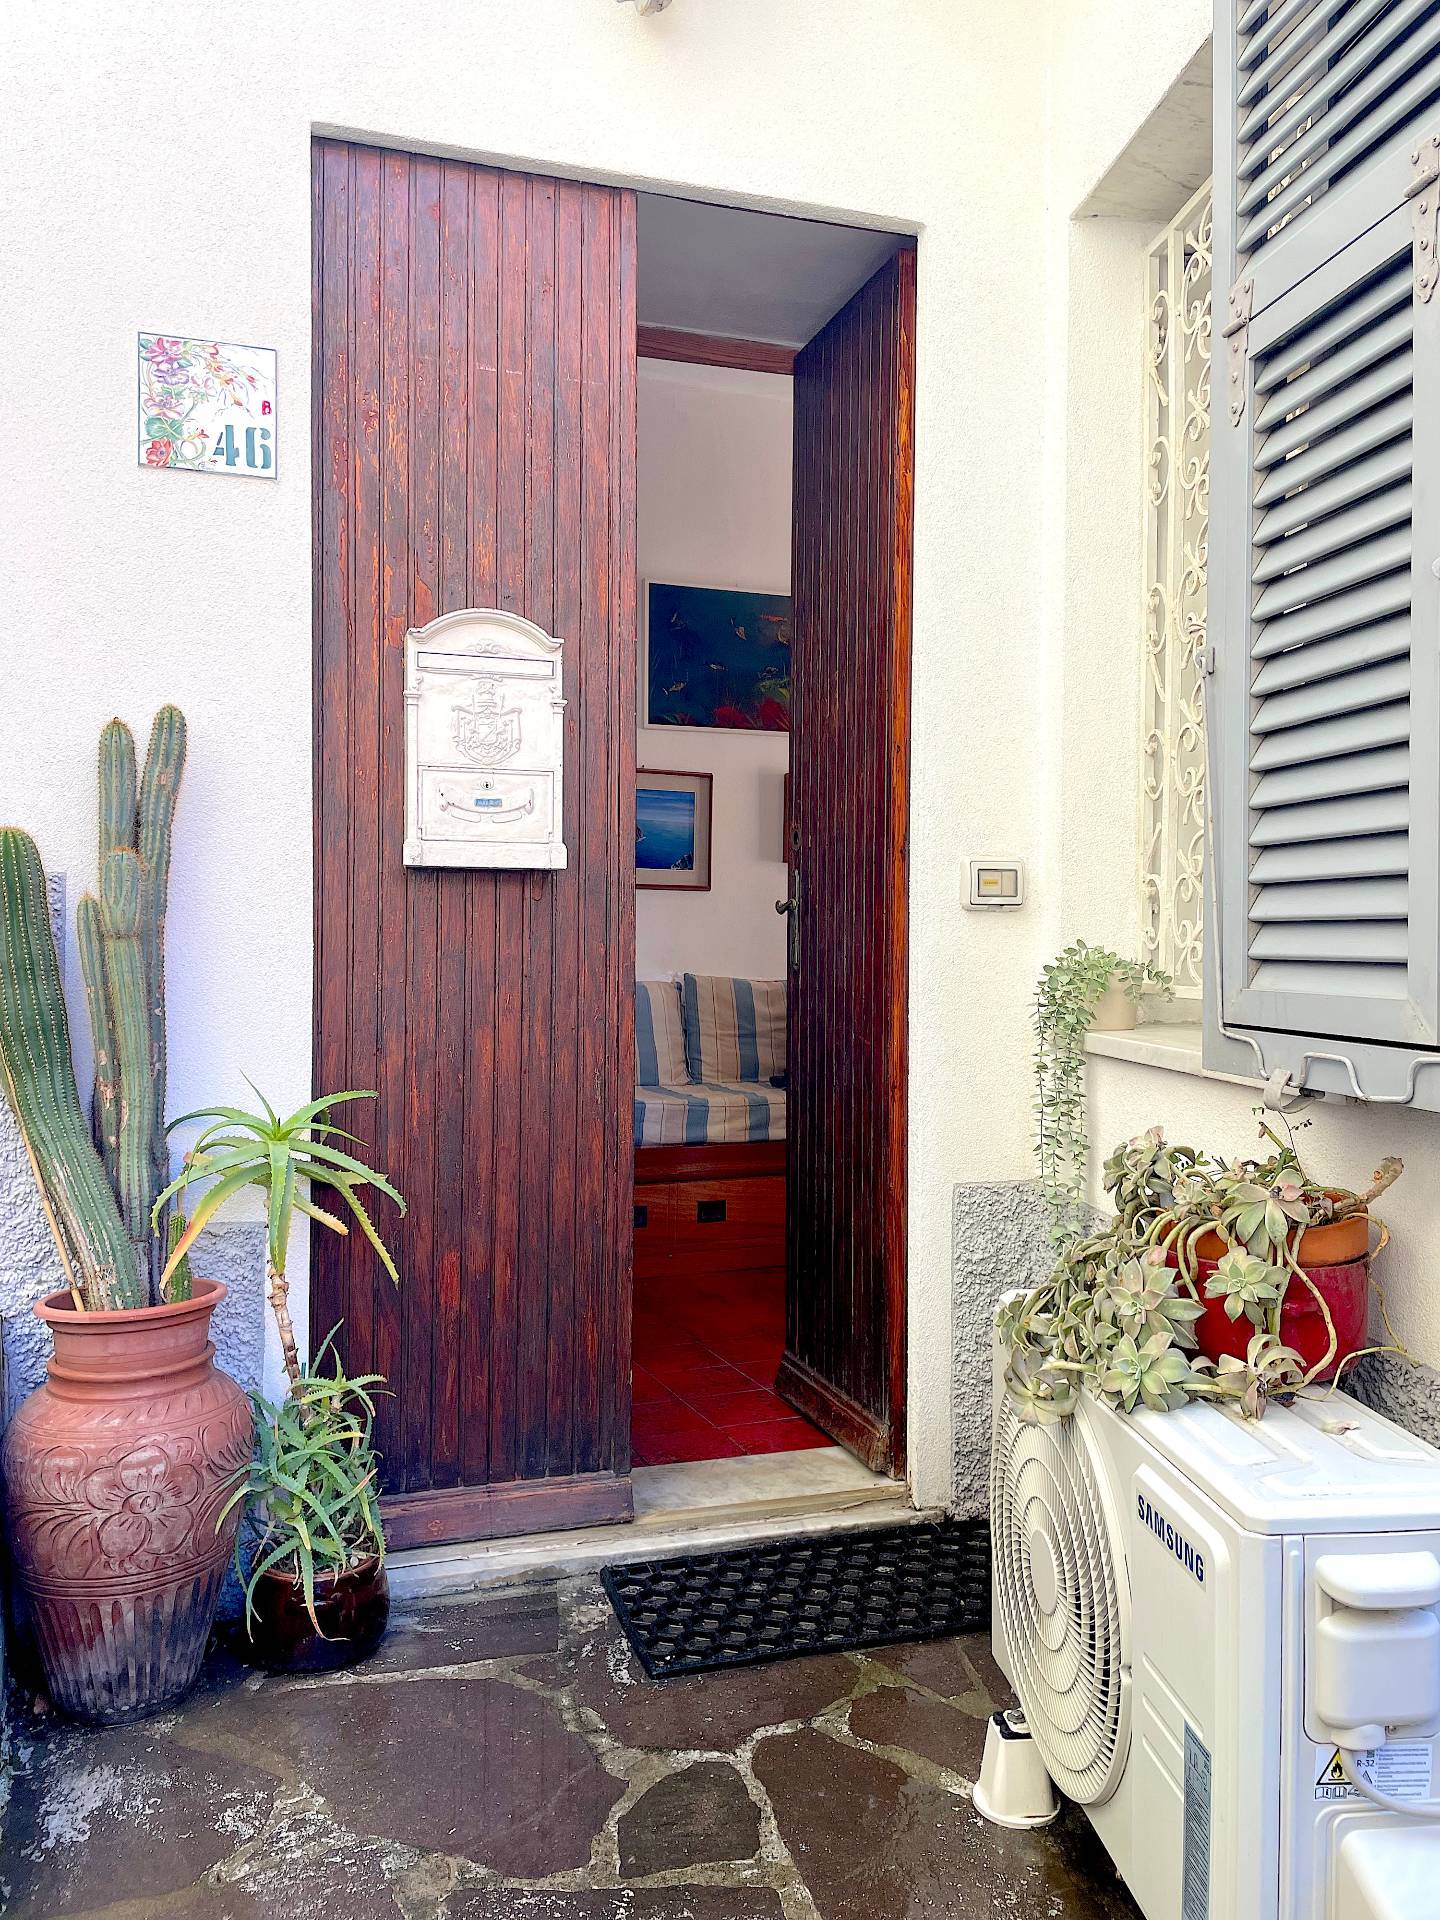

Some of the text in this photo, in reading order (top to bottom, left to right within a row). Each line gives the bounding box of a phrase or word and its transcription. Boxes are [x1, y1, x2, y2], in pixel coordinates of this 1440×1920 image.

[261, 400, 272, 416] B
[213, 424, 272, 470] 46
[1137, 1494, 1204, 1582] SAMSUNG
[1356, 1759, 1375, 1768] R-32
